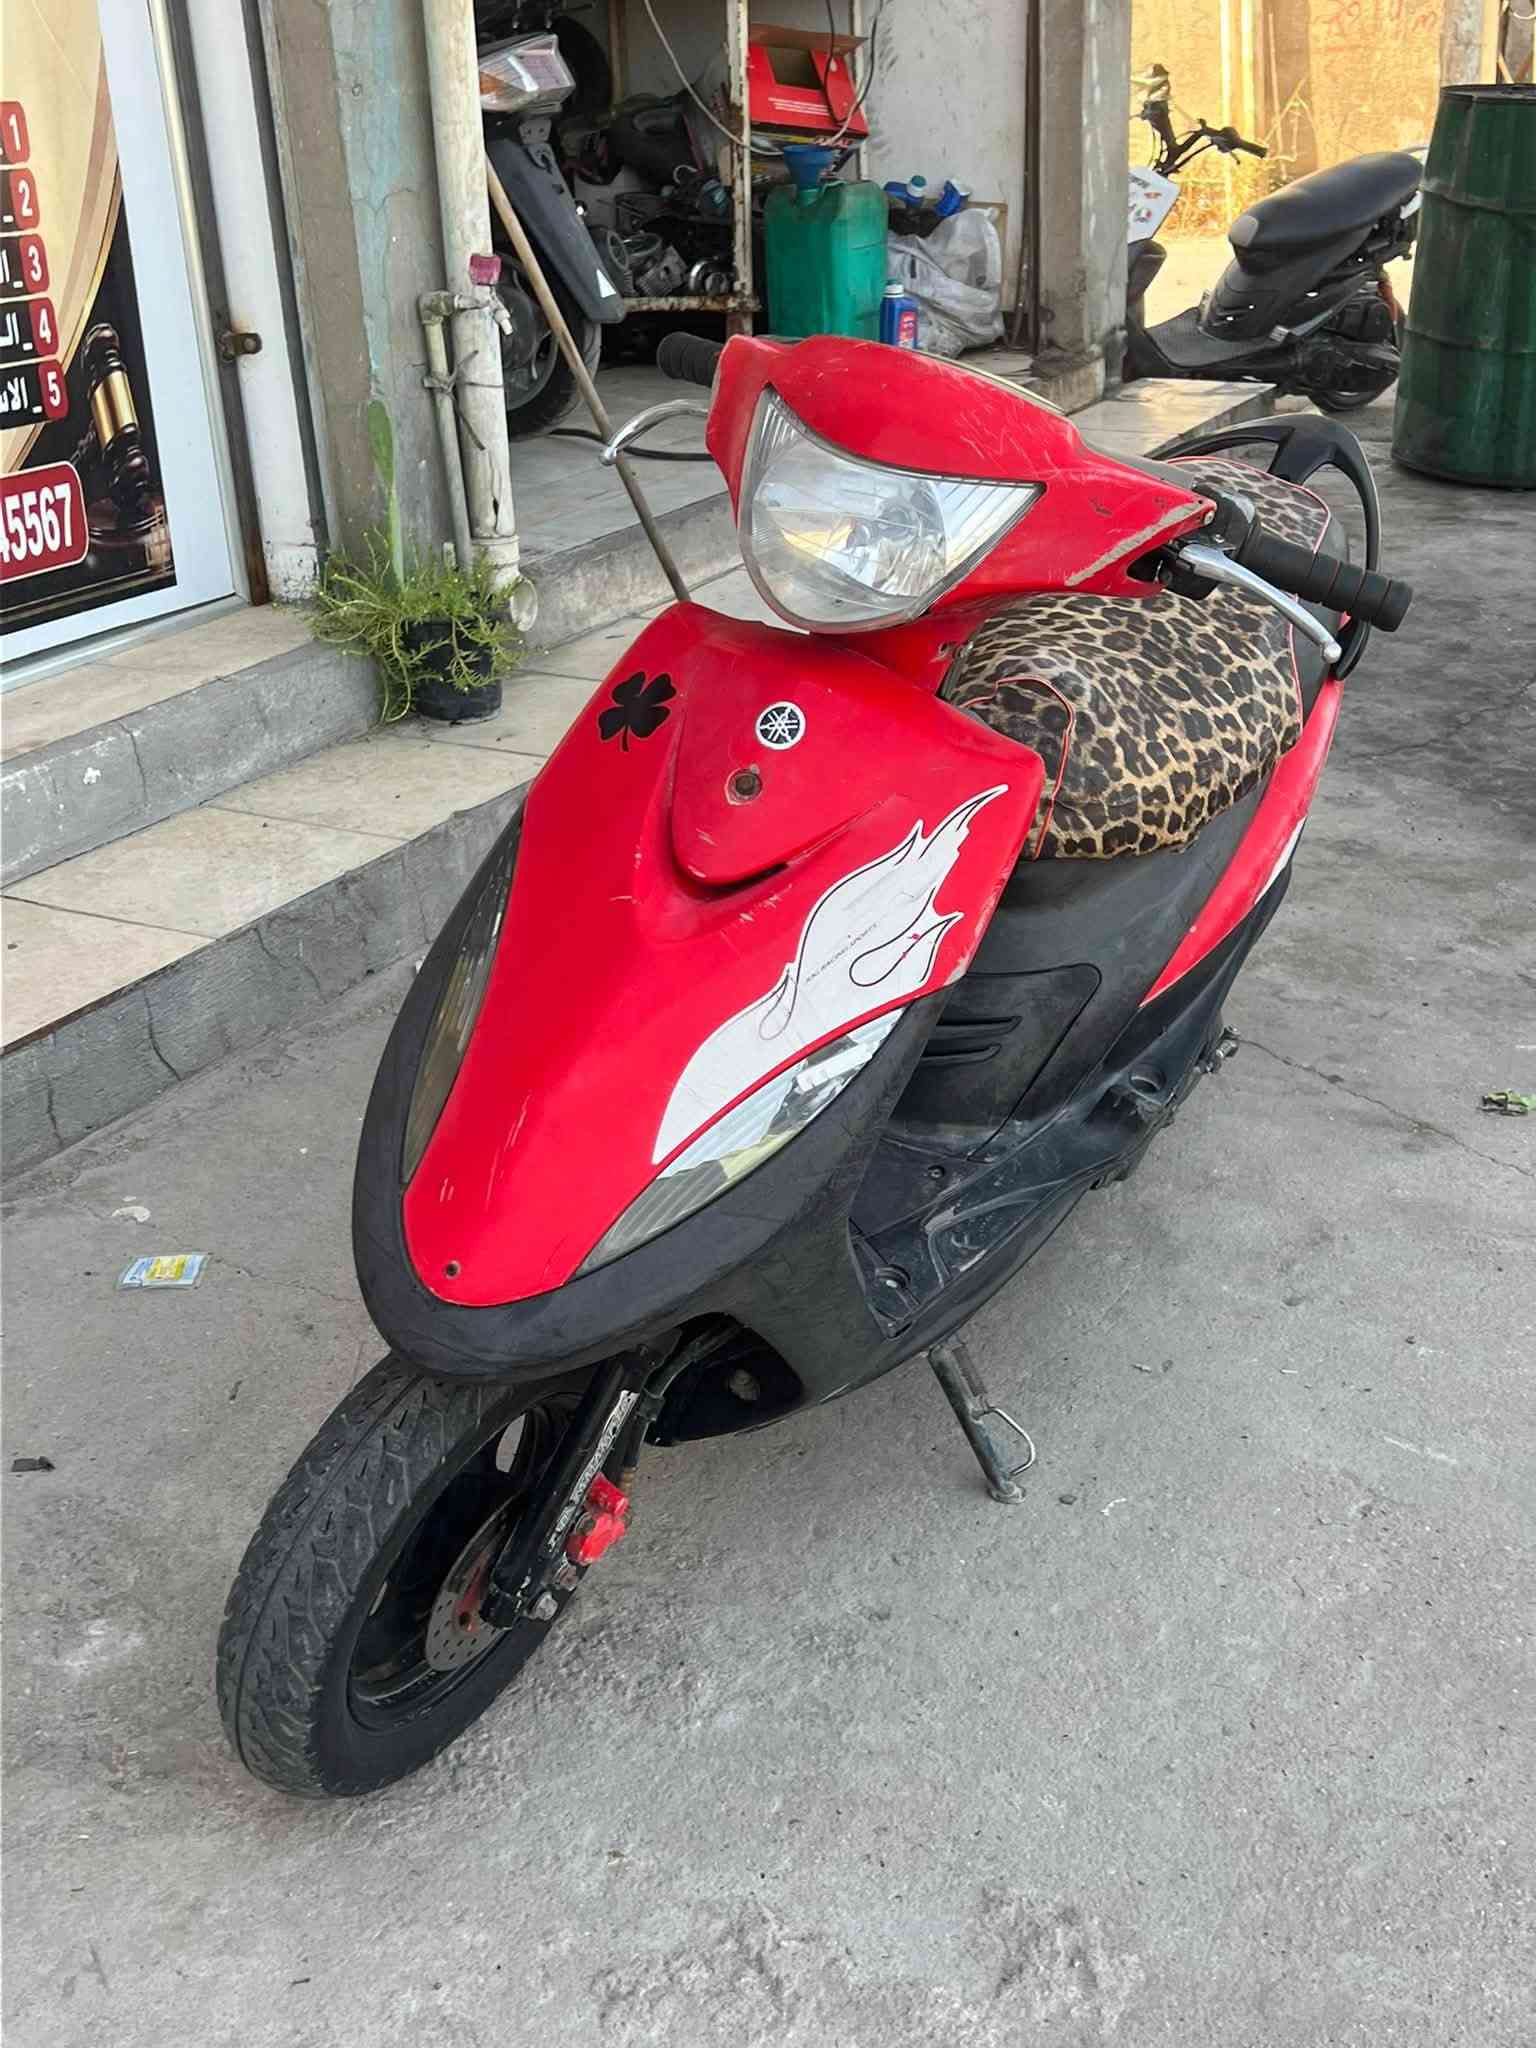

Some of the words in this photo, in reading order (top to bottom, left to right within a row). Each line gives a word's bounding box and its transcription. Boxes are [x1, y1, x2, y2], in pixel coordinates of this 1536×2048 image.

[8, 113, 21, 151] 1
[18, 179, 33, 217] 2
[28, 245, 42, 282] 3
[39, 307, 52, 344] 4
[47, 371, 61, 407] 5
